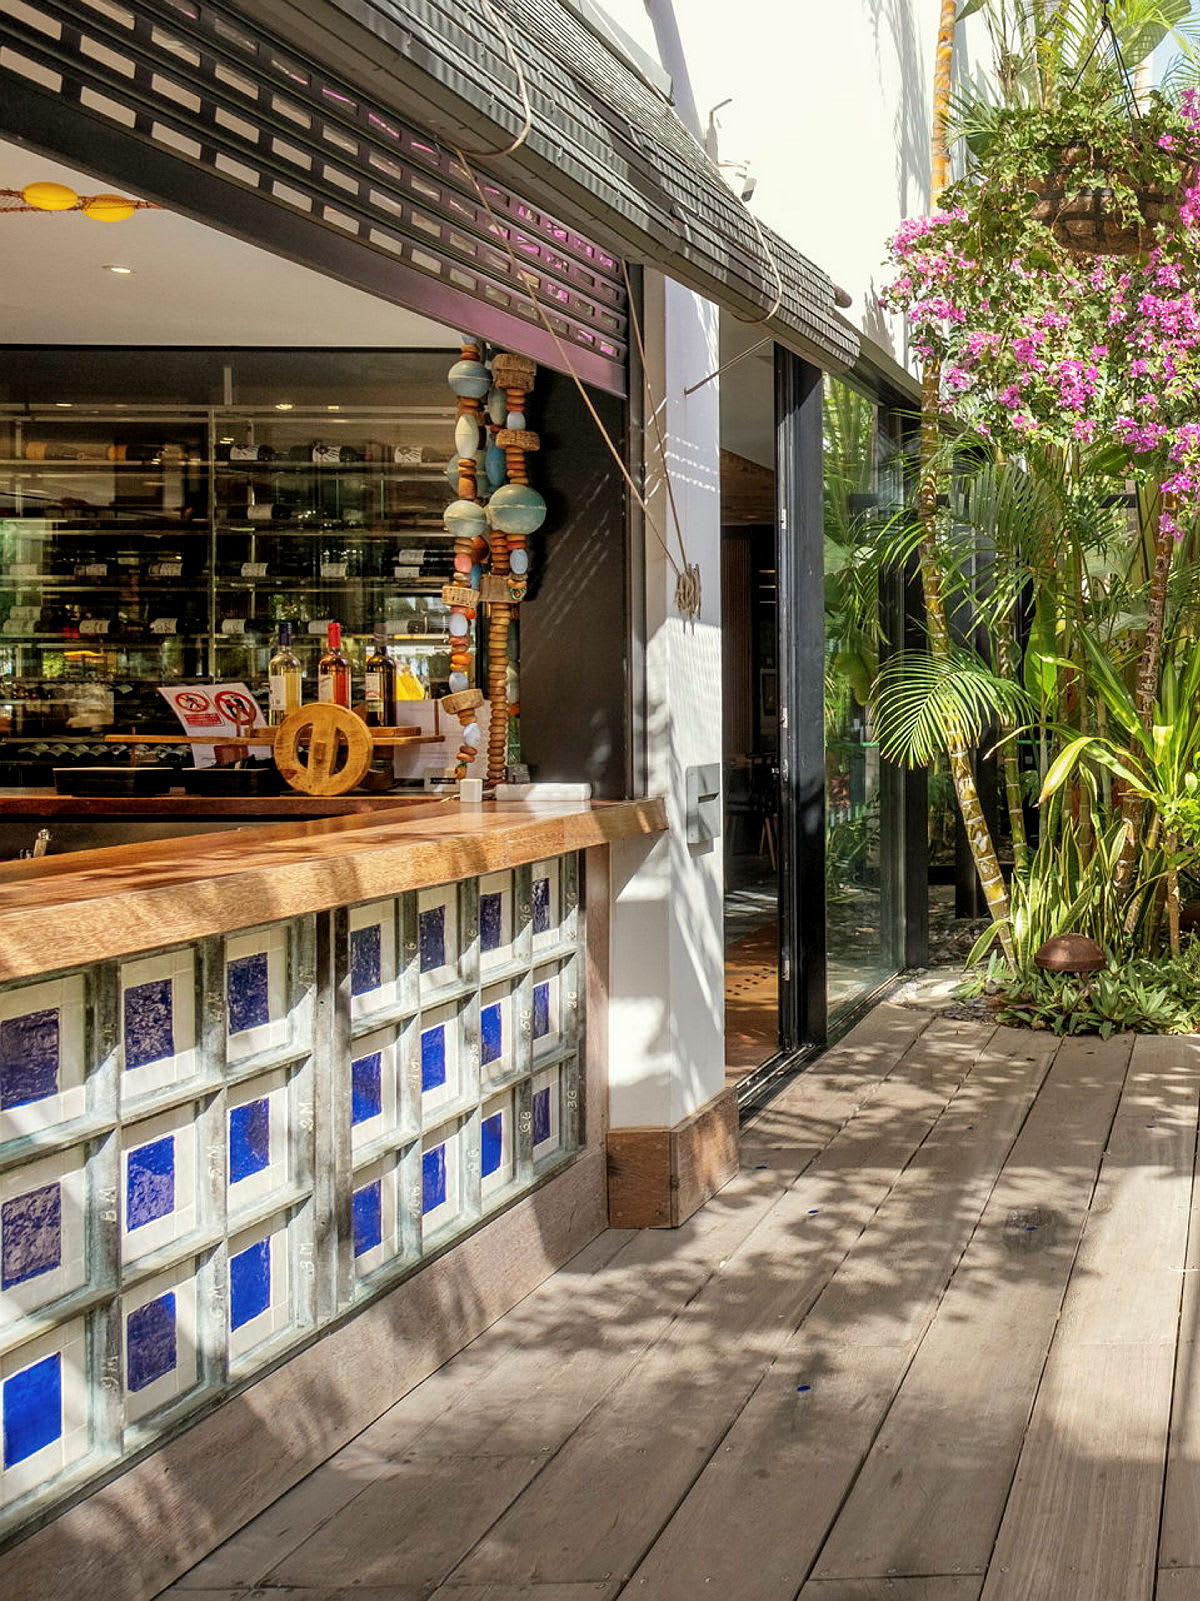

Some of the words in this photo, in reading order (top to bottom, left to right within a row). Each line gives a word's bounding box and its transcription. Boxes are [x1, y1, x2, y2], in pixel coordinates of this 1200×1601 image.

[520, 1009, 531, 1030] 5G
[567, 1090, 577, 1108] 3G
[299, 1102, 314, 1130] 2M
[520, 1111, 532, 1133] 6G
[299, 1242, 315, 1271] 3M
[208, 1283, 225, 1318] 6M
